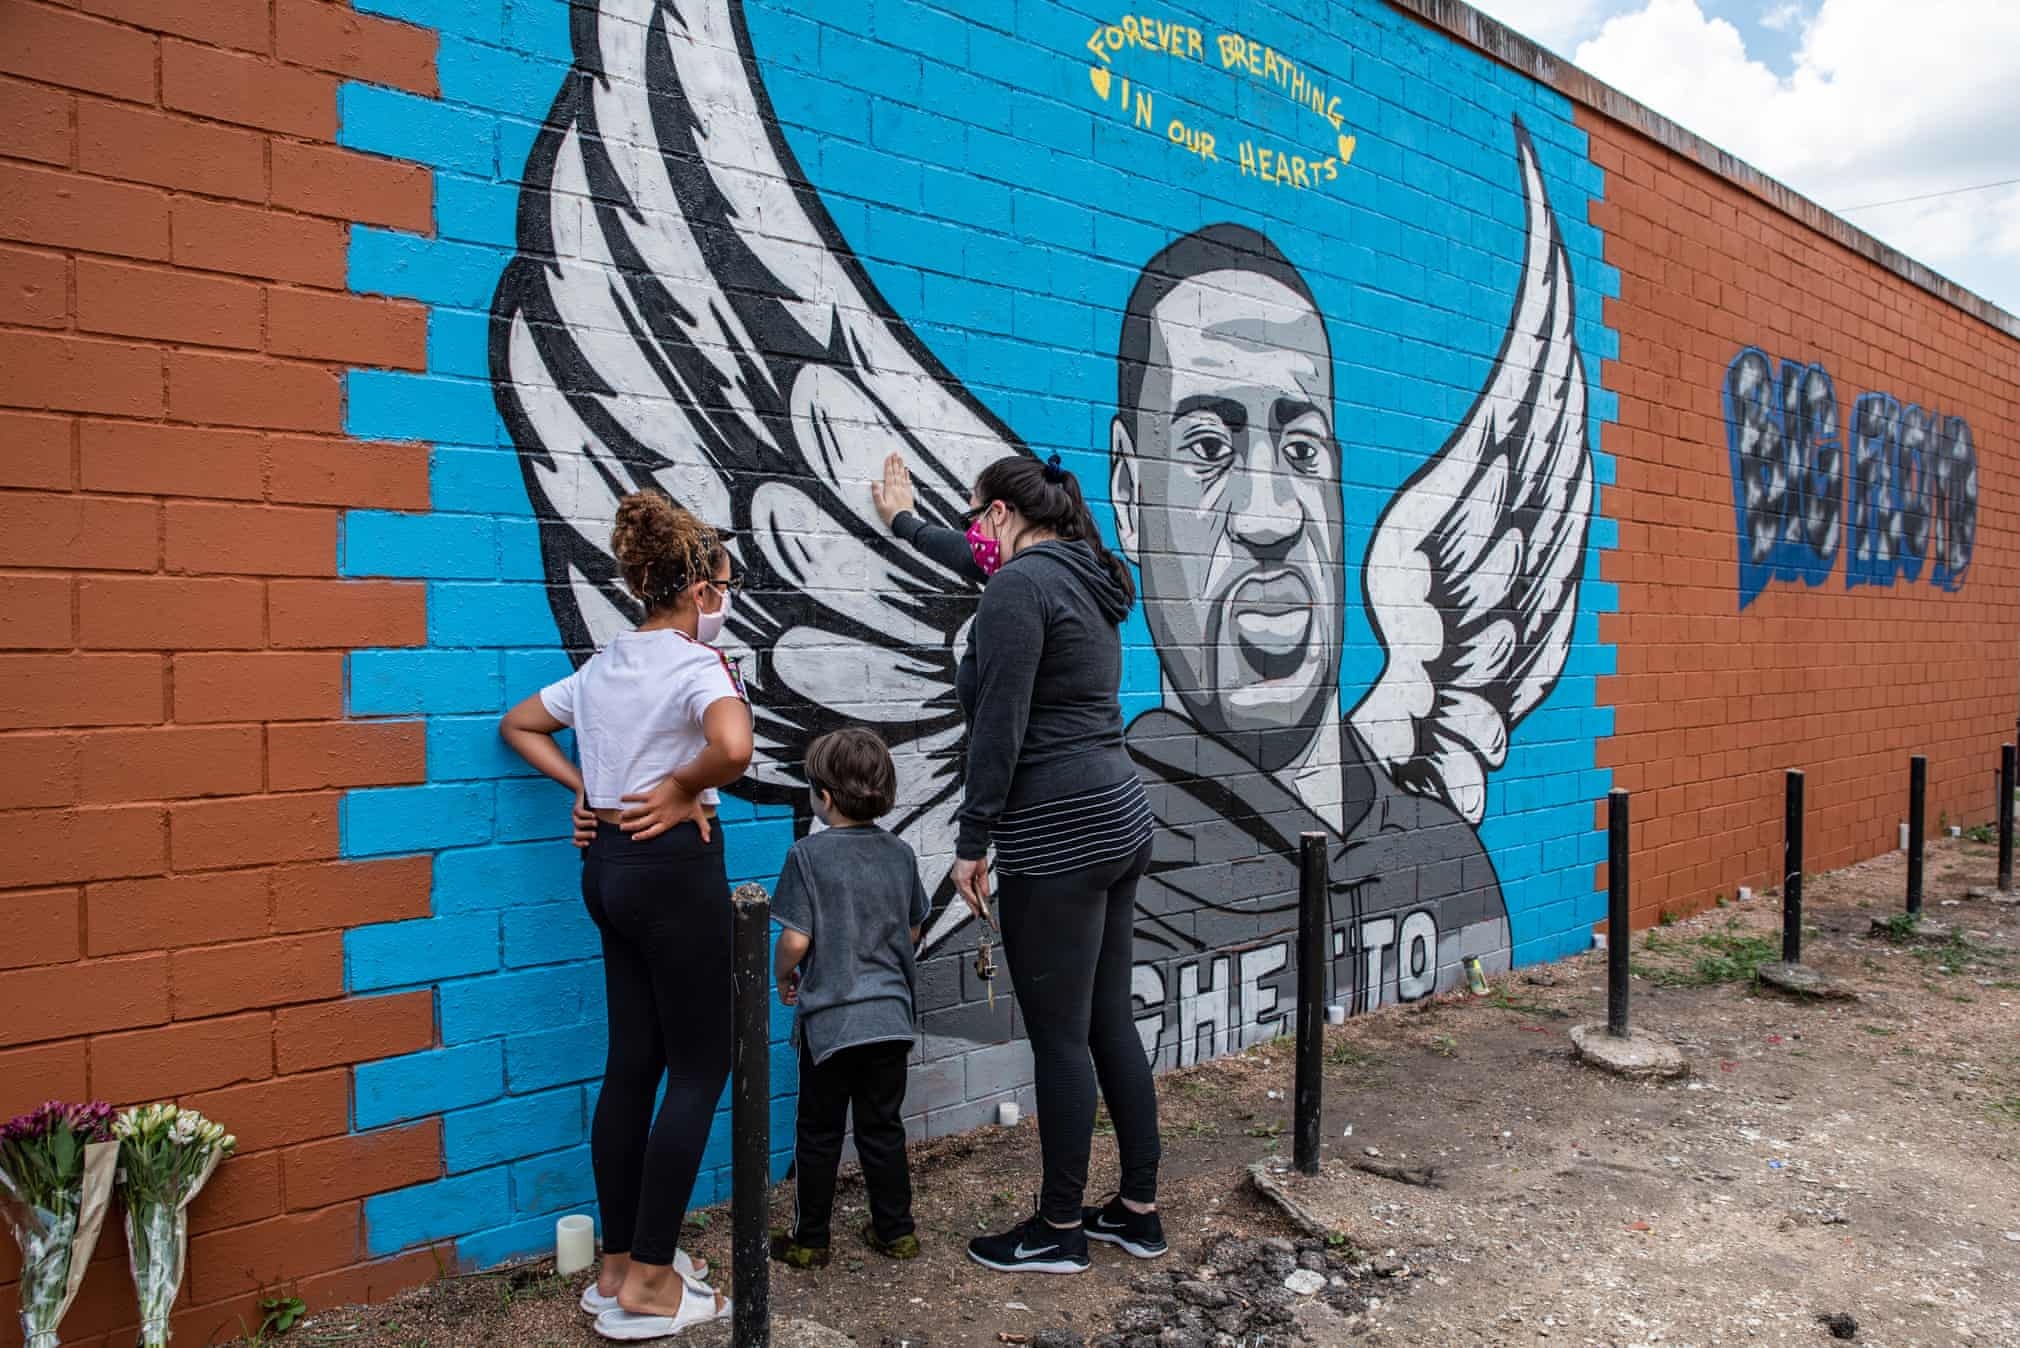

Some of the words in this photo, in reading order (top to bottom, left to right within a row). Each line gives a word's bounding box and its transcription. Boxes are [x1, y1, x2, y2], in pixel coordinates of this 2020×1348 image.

[1087, 15, 1205, 64] FOREVER
[1217, 33, 1345, 131] BREATHING
[1121, 77, 1153, 129] IN
[1168, 119, 1218, 162] OUR
[1239, 140, 1338, 189] HEARTS
[1722, 345, 1843, 611] BIG
[1131, 908, 1440, 1068] GHETO
